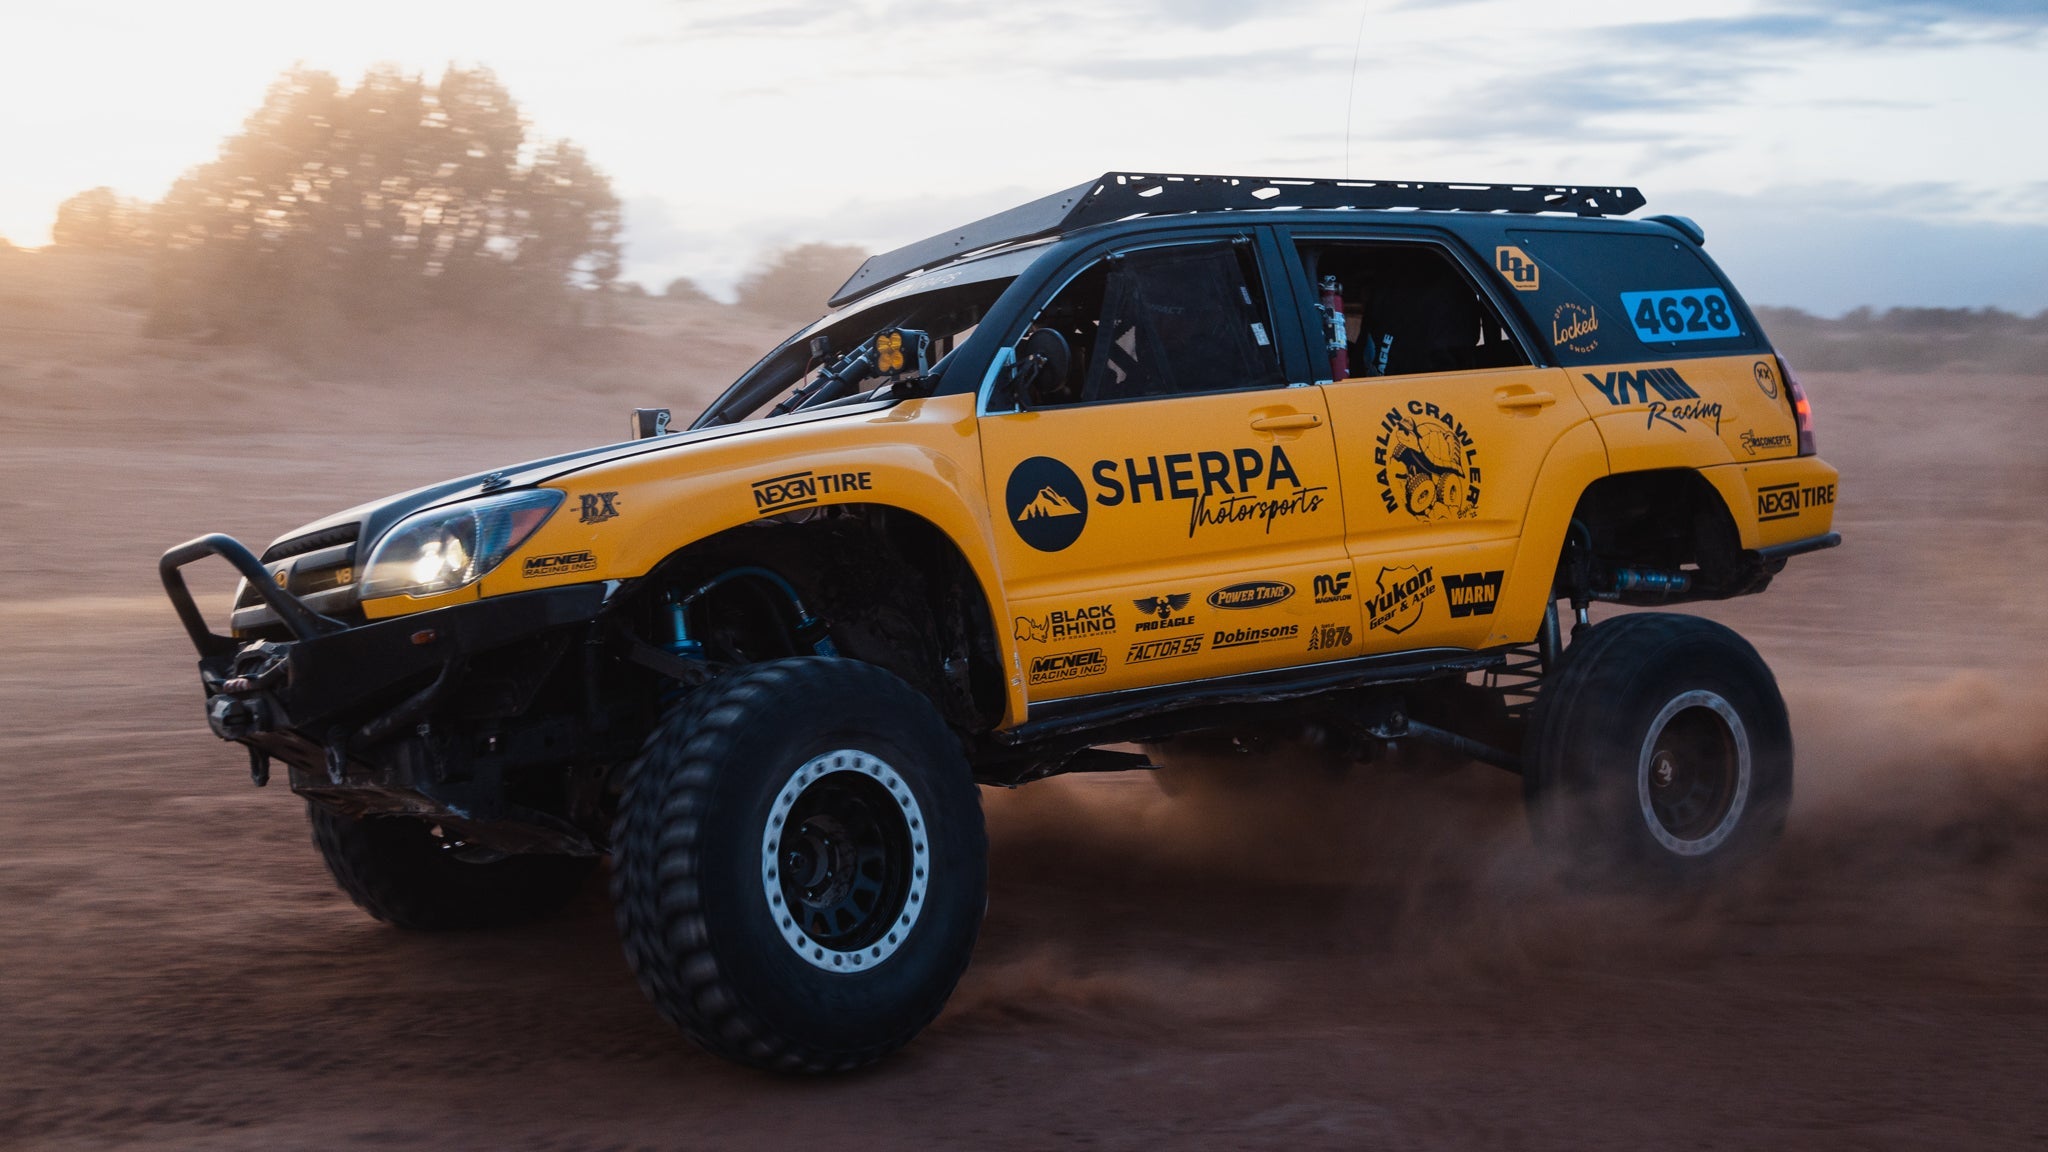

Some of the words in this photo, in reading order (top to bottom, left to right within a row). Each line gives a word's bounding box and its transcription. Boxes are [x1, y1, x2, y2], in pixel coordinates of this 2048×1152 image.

[1553, 305, 1598, 346] Locked
[1634, 295, 1731, 334] 4628
[1569, 340, 1598, 353] SHOCKS
[1647, 400, 1722, 436] Racing
[1375, 407, 1402, 514] MARLIN
[1407, 400, 1481, 508] CRAWLER
[1092, 445, 1301, 507] SHERPA
[753, 478, 816, 508] NEXEN
[817, 472, 872, 493] TIRE
[1758, 490, 1799, 515] NEXEN
[1801, 484, 1834, 508] TIRE
[578, 491, 619, 523] RX
[1189, 486, 1328, 538] Motorsports
[524, 564, 570, 577] RACING
[571, 561, 596, 571] INC.
[525, 551, 593, 570] MCNEIL
[1218, 589, 1255, 605] POWER
[1256, 585, 1286, 600] TANK
[1315, 594, 1352, 604] MAGNAFLOW
[1365, 566, 1433, 619] Yukon
[1451, 584, 1495, 606] WARN
[1051, 604, 1113, 624] BLACK
[1370, 609, 1396, 630] Gear
[1400, 602, 1408, 612] &
[1412, 584, 1436, 604] Axle
[1052, 617, 1116, 638] RHINO
[1135, 621, 1158, 632] PRO
[1160, 616, 1195, 629] EAGLE
[1212, 624, 1298, 645] Dobinsons
[1125, 640, 1182, 662] FACTOR
[1182, 636, 1203, 653] 55
[1320, 626, 1352, 649] 1876
[1032, 651, 1105, 673] MCNEIL
[1032, 667, 1077, 682] RACING
[1080, 662, 1106, 674] INC.
